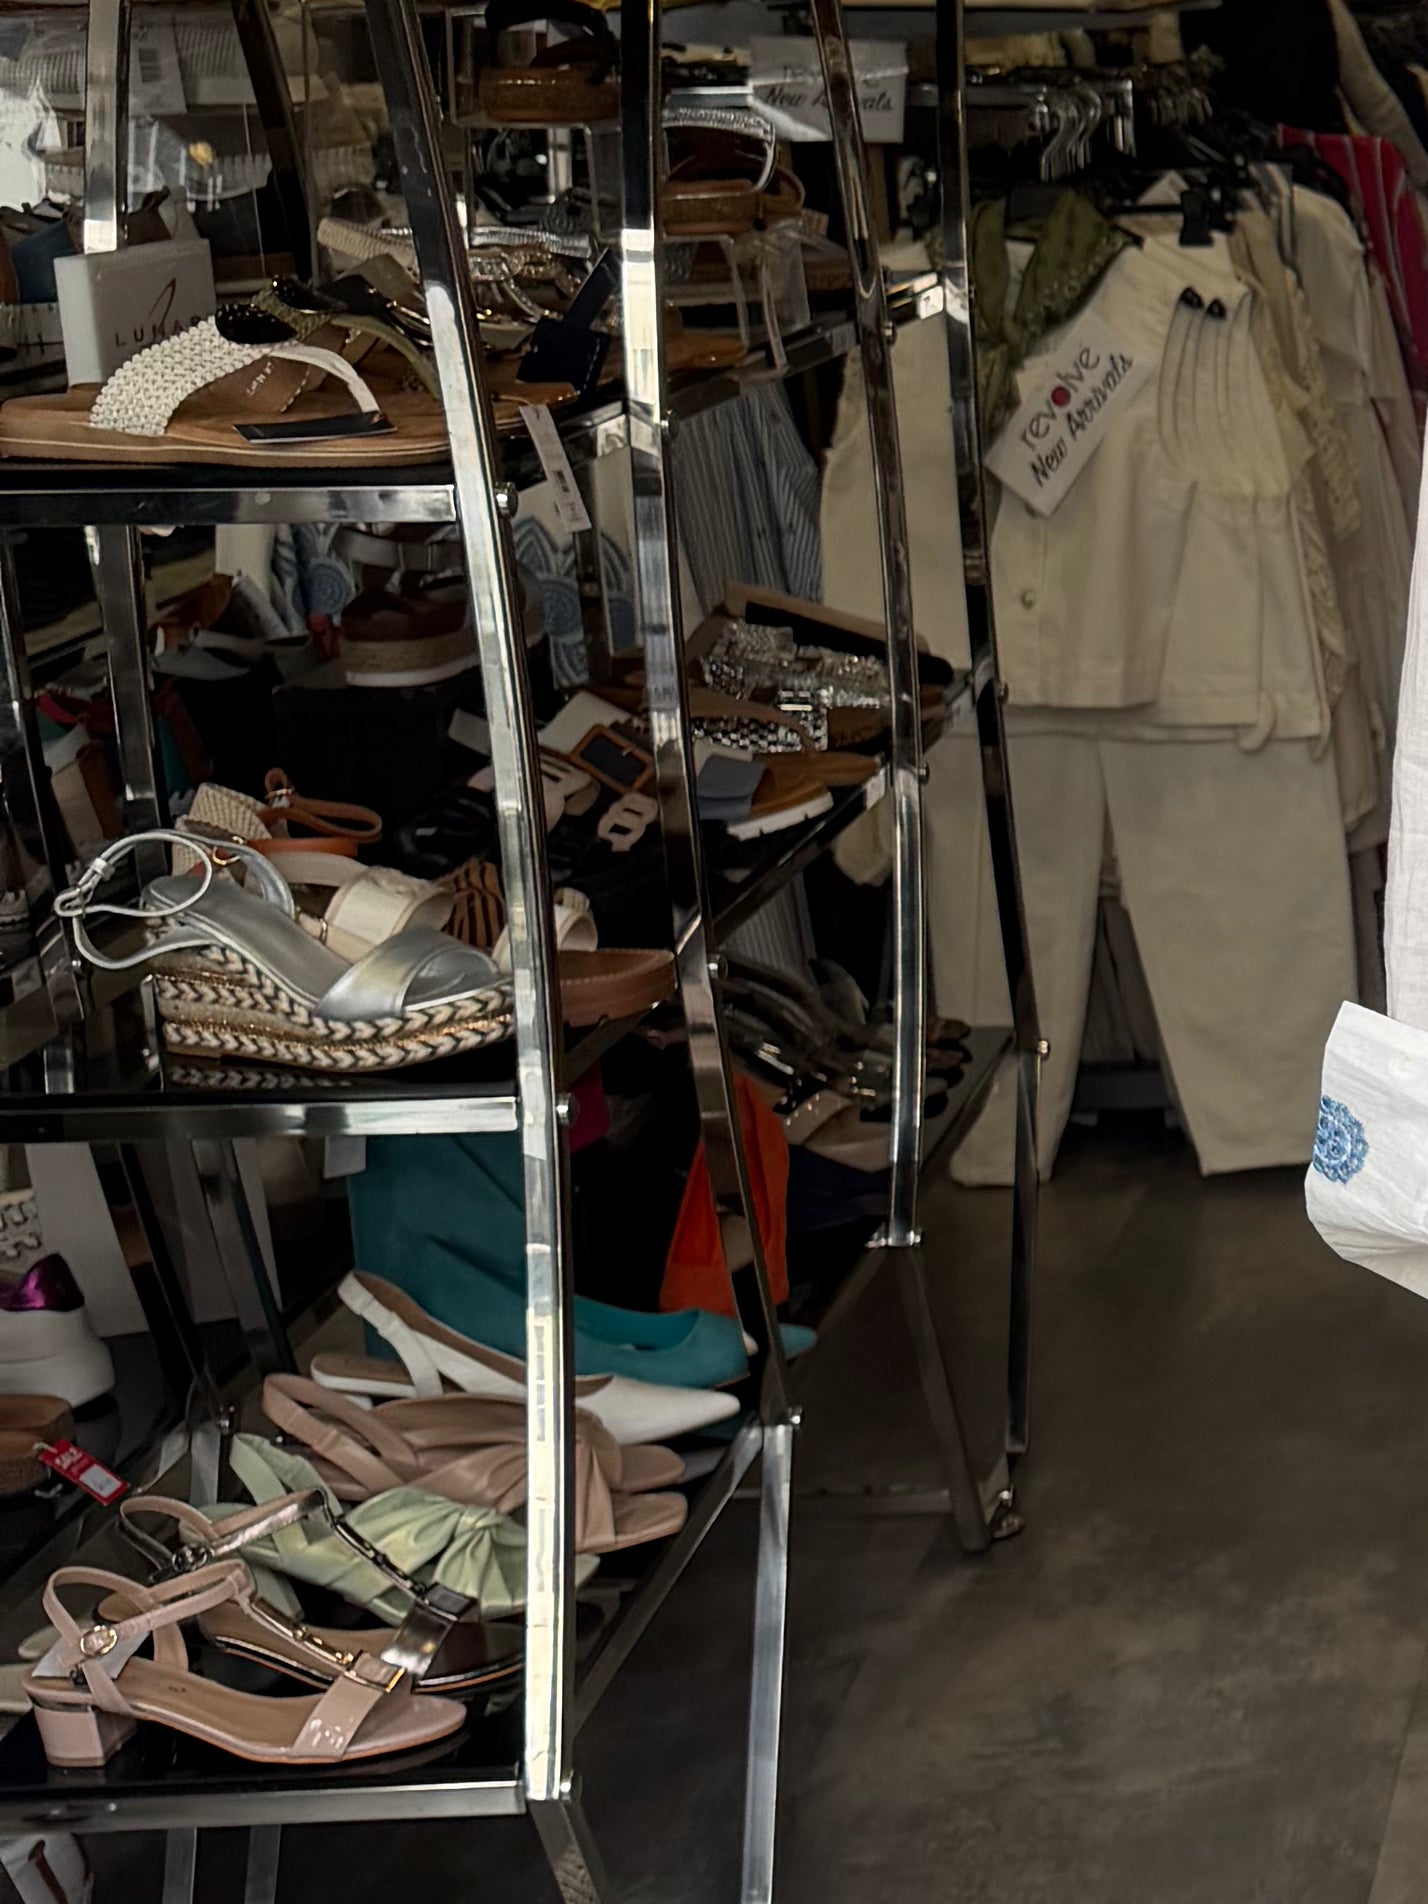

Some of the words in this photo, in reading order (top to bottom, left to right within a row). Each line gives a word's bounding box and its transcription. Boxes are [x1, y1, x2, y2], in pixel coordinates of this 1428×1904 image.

[1019, 346, 1101, 449] revolve
[1027, 435, 1069, 488] New
[1064, 352, 1134, 442] Arrivals
